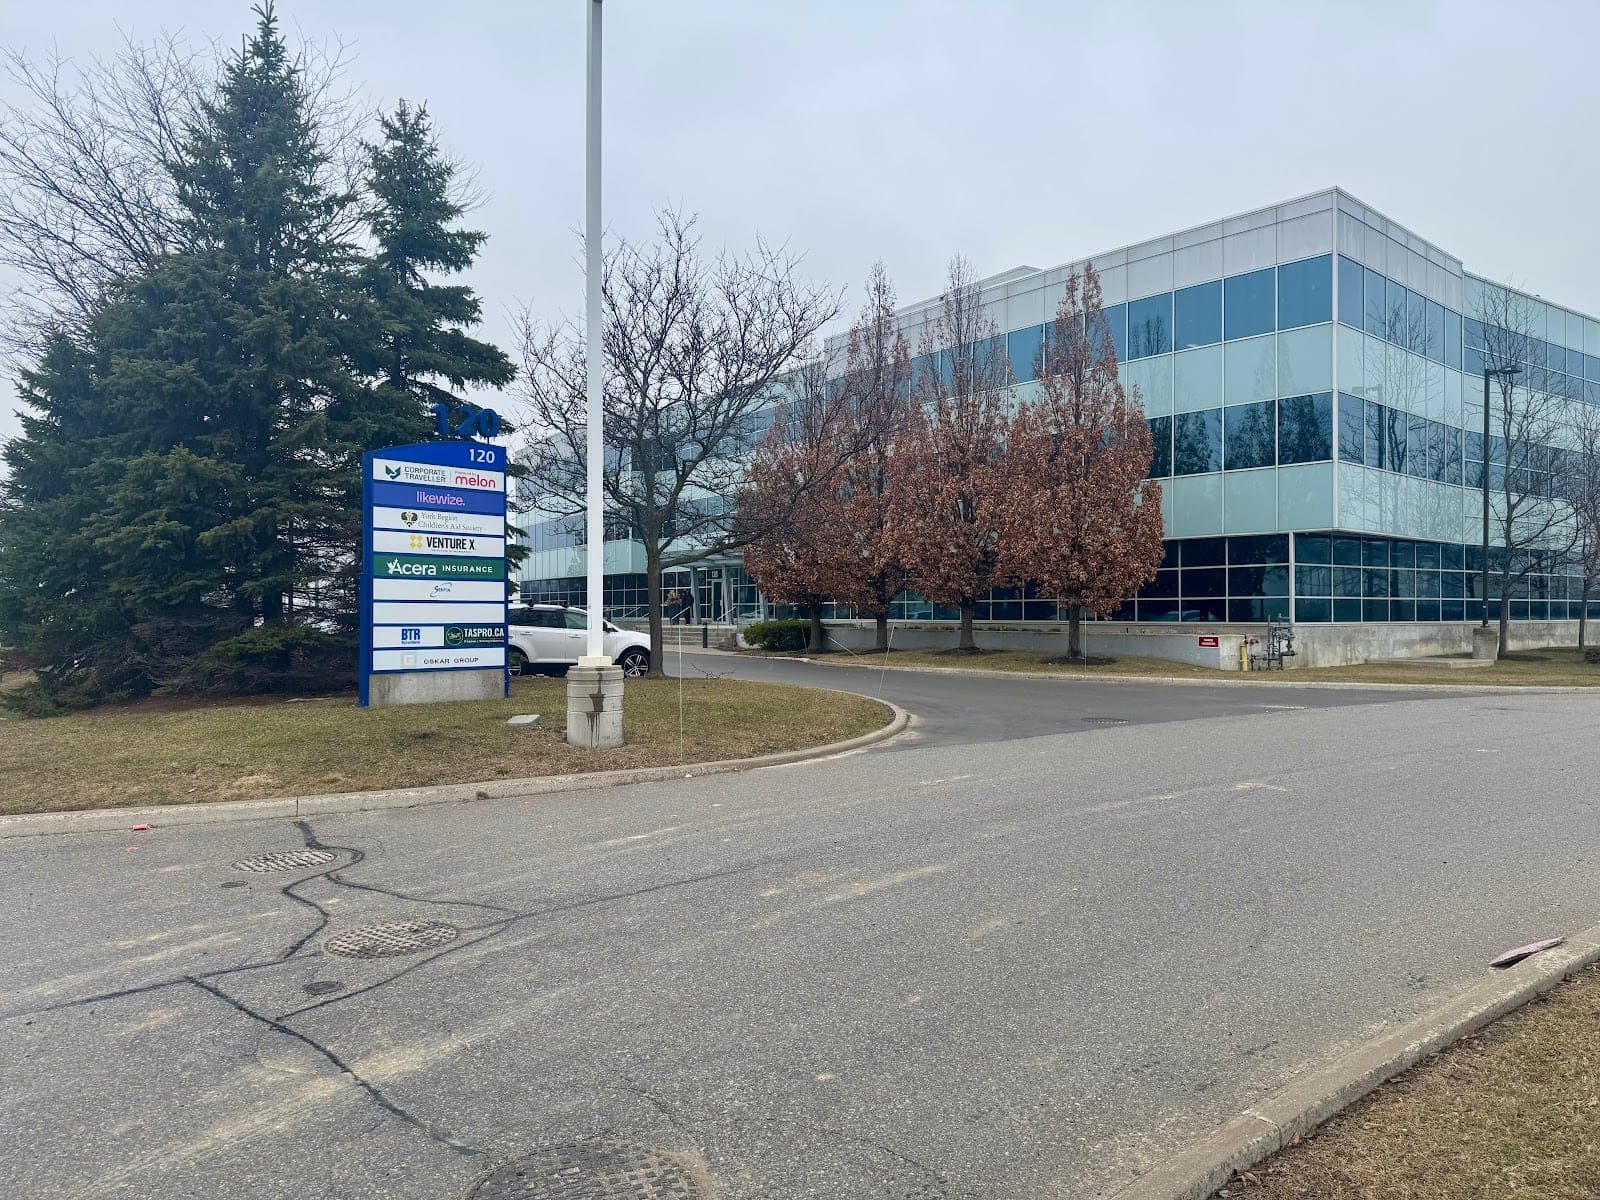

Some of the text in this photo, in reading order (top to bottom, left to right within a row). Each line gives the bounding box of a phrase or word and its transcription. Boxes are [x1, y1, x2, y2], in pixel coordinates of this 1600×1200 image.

[430, 403, 500, 437] 120
[469, 448, 495, 464] 120
[404, 466, 446, 477] CORPORATE
[404, 473, 446, 483] TRAVELLER
[455, 474, 496, 488] melon
[416, 491, 466, 506] likewize.
[421, 512, 458, 522] York Region
[418, 521, 449, 529] Children's
[426, 536, 475, 550] VENTURE X
[388, 558, 493, 575] Acera INSURANCE
[401, 628, 421, 640] BTR
[464, 628, 504, 638] TASPRO.CA
